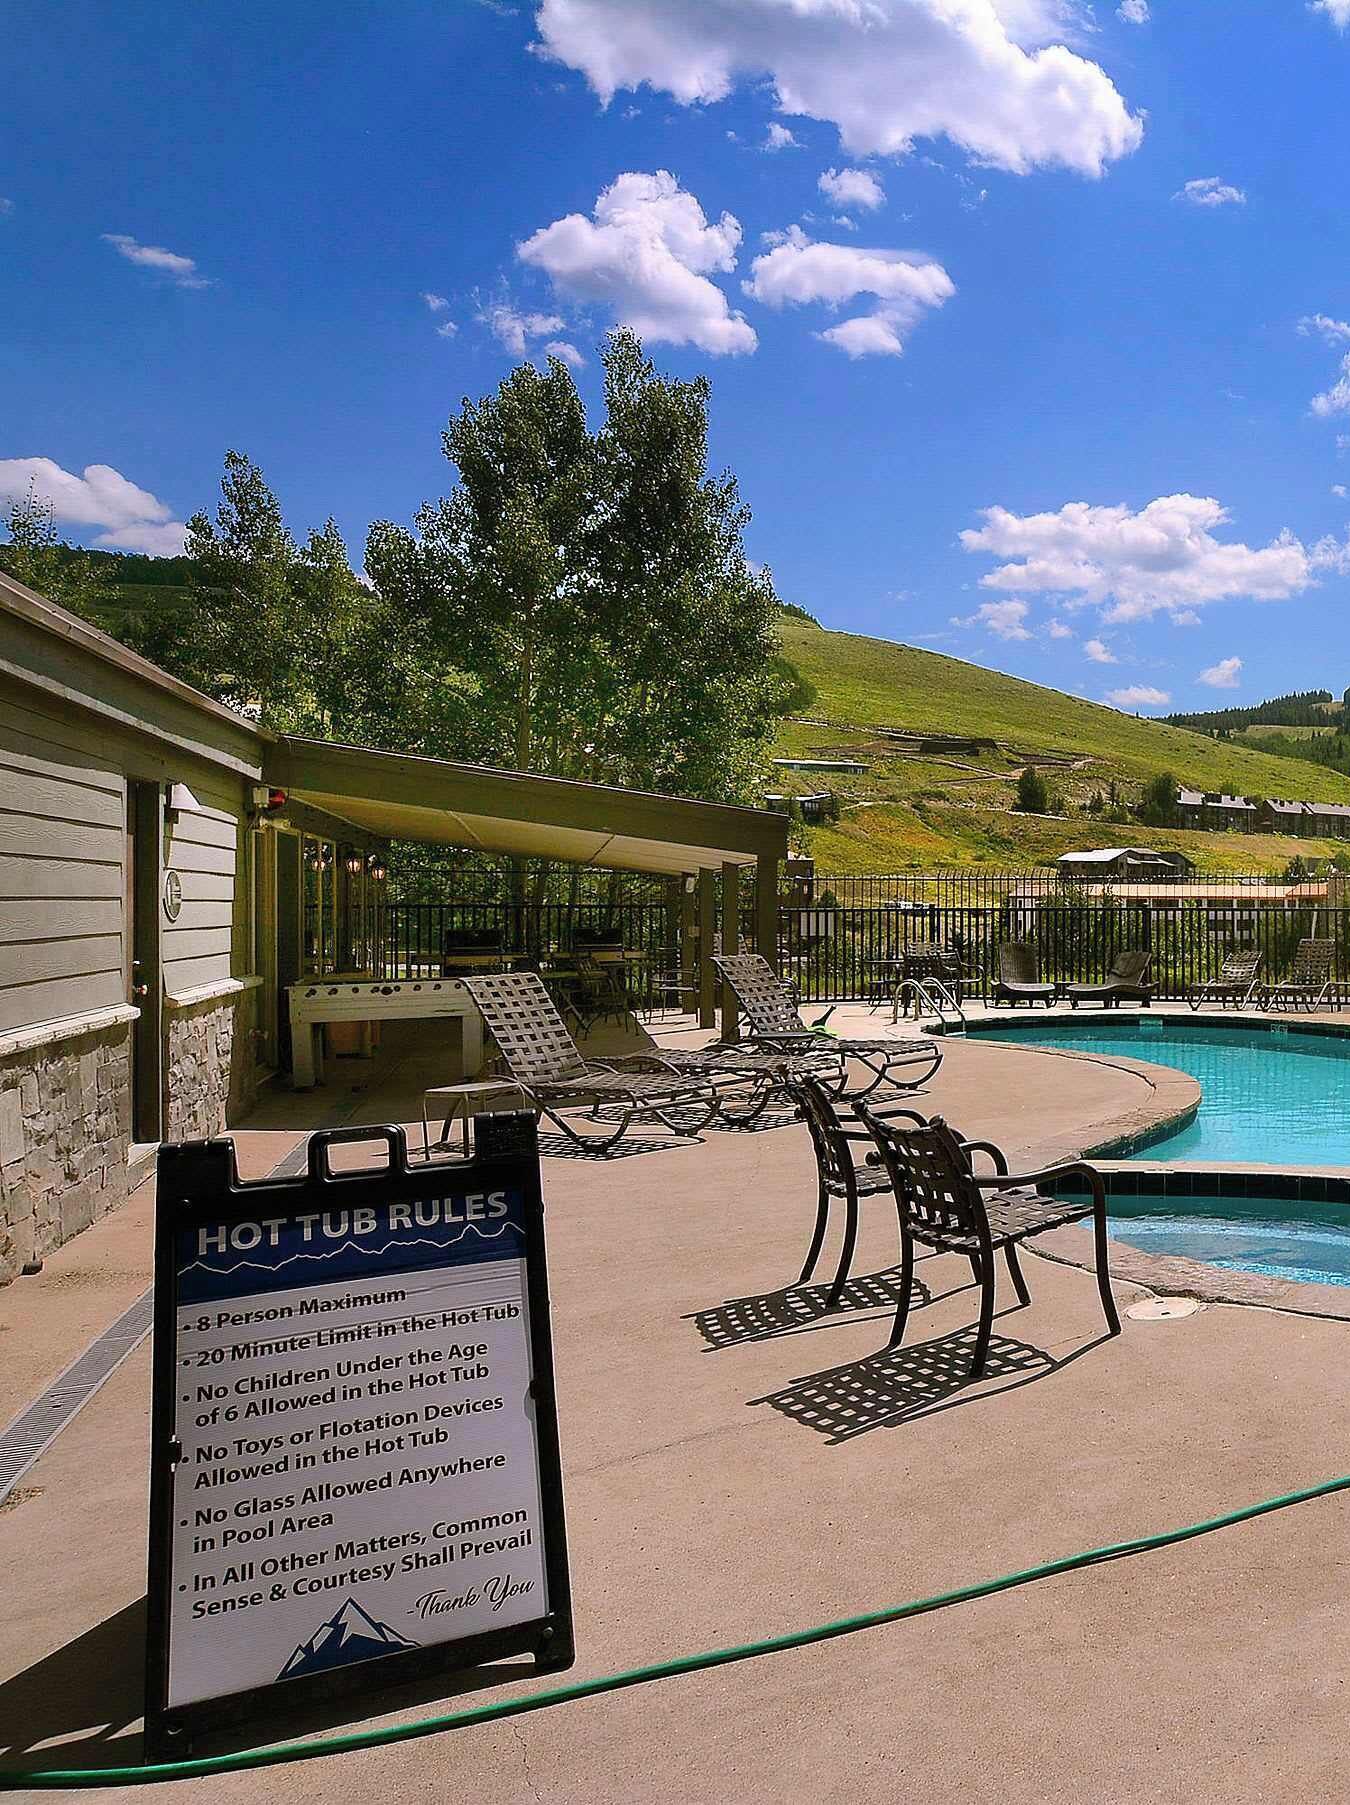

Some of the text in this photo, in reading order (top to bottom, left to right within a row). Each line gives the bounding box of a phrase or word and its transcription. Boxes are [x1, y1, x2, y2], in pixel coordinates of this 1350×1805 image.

[198, 1192, 507, 1255] HOT TUB RULES
[197, 1289, 406, 1331] 8 Person Maximum
[197, 1304, 519, 1367] 20 Minute Limit in the Hot Tub
[196, 1363, 488, 1427] of 6 Allowed in the Hot Tub
[197, 1344, 487, 1402] No Children Under the Age
[194, 1427, 448, 1490] Allowed in the Hot Tub
[197, 1398, 503, 1464] No Toys or Flotation Devices
[196, 1456, 505, 1526] No Glass Allowed Anywhere
[194, 1514, 333, 1553] in Pool Area
[194, 1510, 527, 1592] In All Other Matters, Common
[192, 1529, 531, 1619] Sense & Courtesy Shall Prevail
[484, 1574, 534, 1611] You
